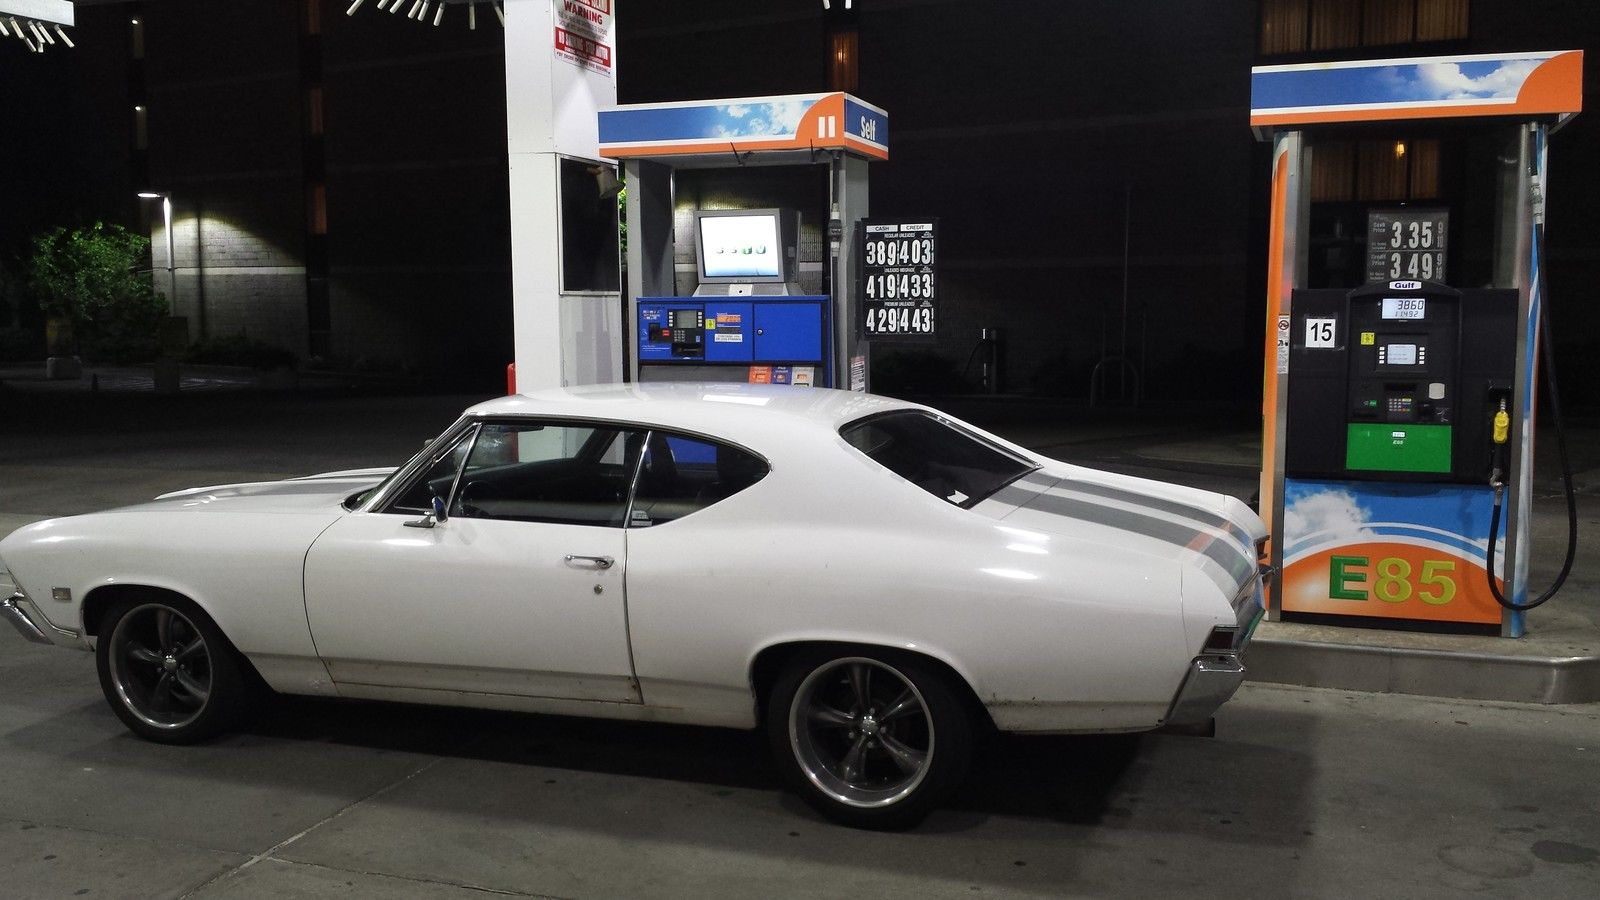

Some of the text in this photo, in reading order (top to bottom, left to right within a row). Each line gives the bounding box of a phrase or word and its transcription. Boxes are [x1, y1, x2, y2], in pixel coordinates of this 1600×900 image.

[564, 0, 603, 25] WARNING
[860, 115, 876, 141] Self
[1391, 221, 1432, 249] 3.35
[1310, 322, 1333, 342] 15
[1329, 555, 1457, 605] E85
